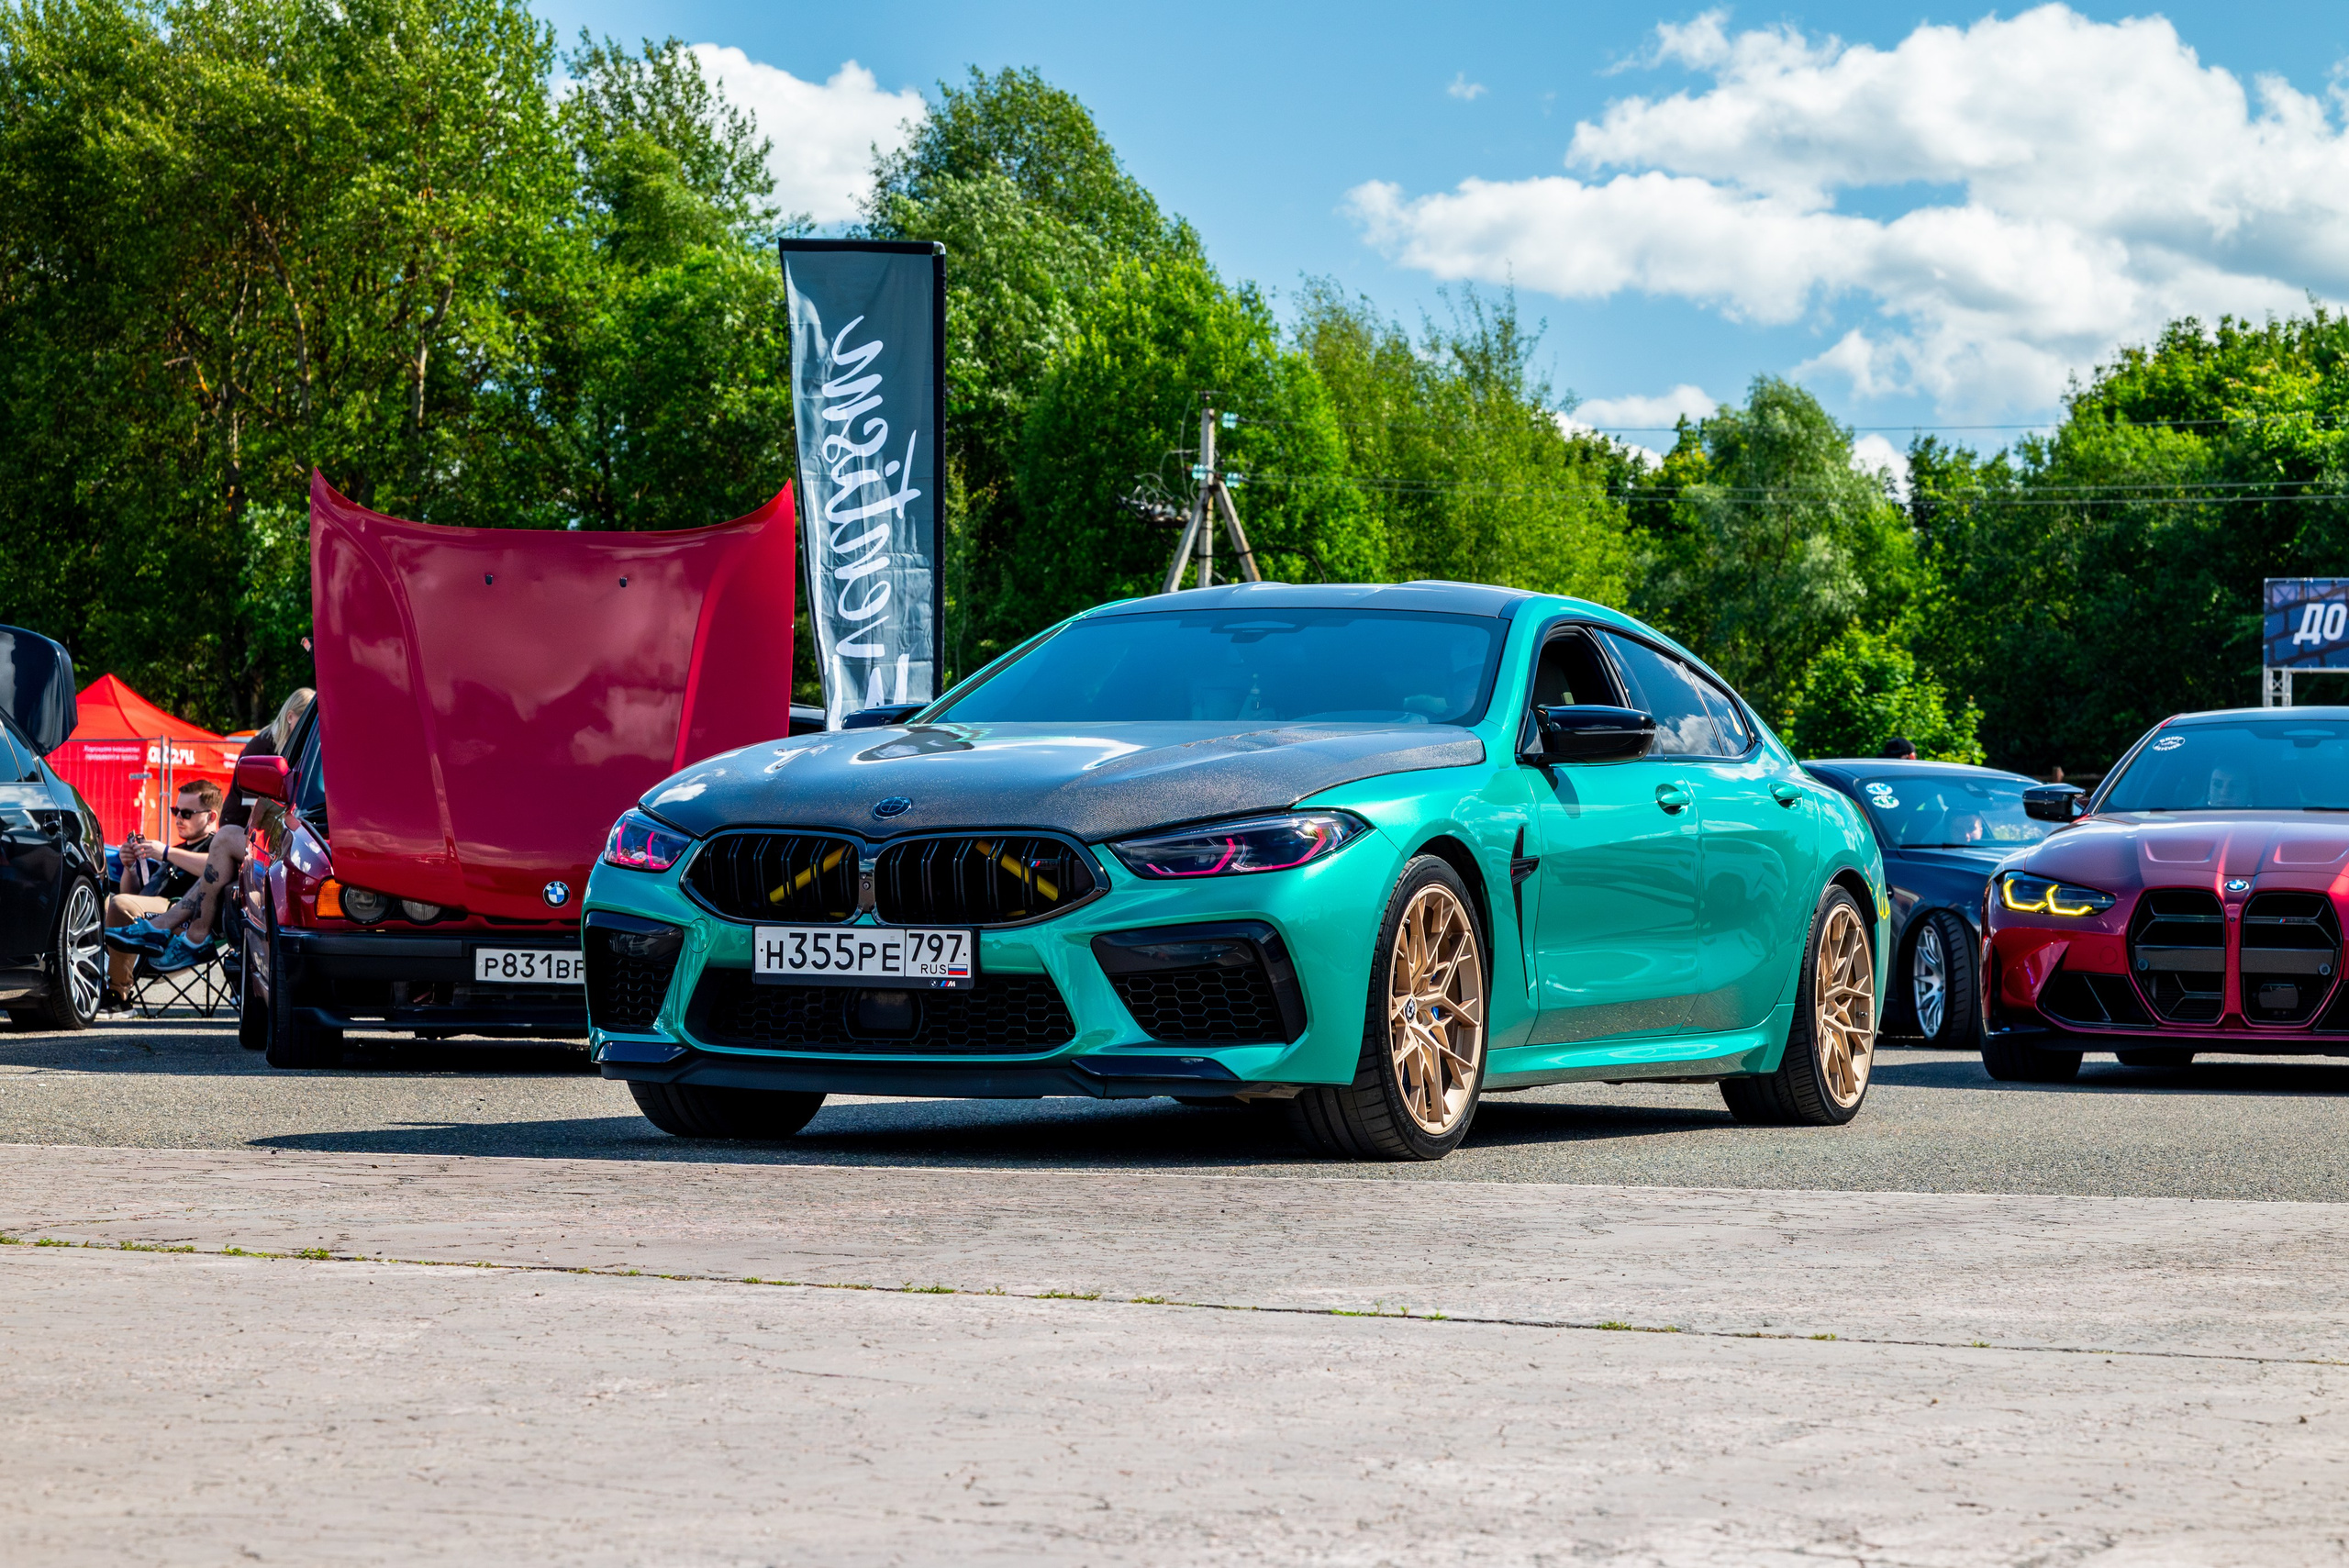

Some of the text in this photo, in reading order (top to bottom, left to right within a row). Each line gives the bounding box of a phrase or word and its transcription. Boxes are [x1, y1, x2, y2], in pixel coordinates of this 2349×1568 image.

[2292, 603, 2348, 645] ДО
[908, 933, 963, 962] 797
[920, 964, 947, 974] RUS
